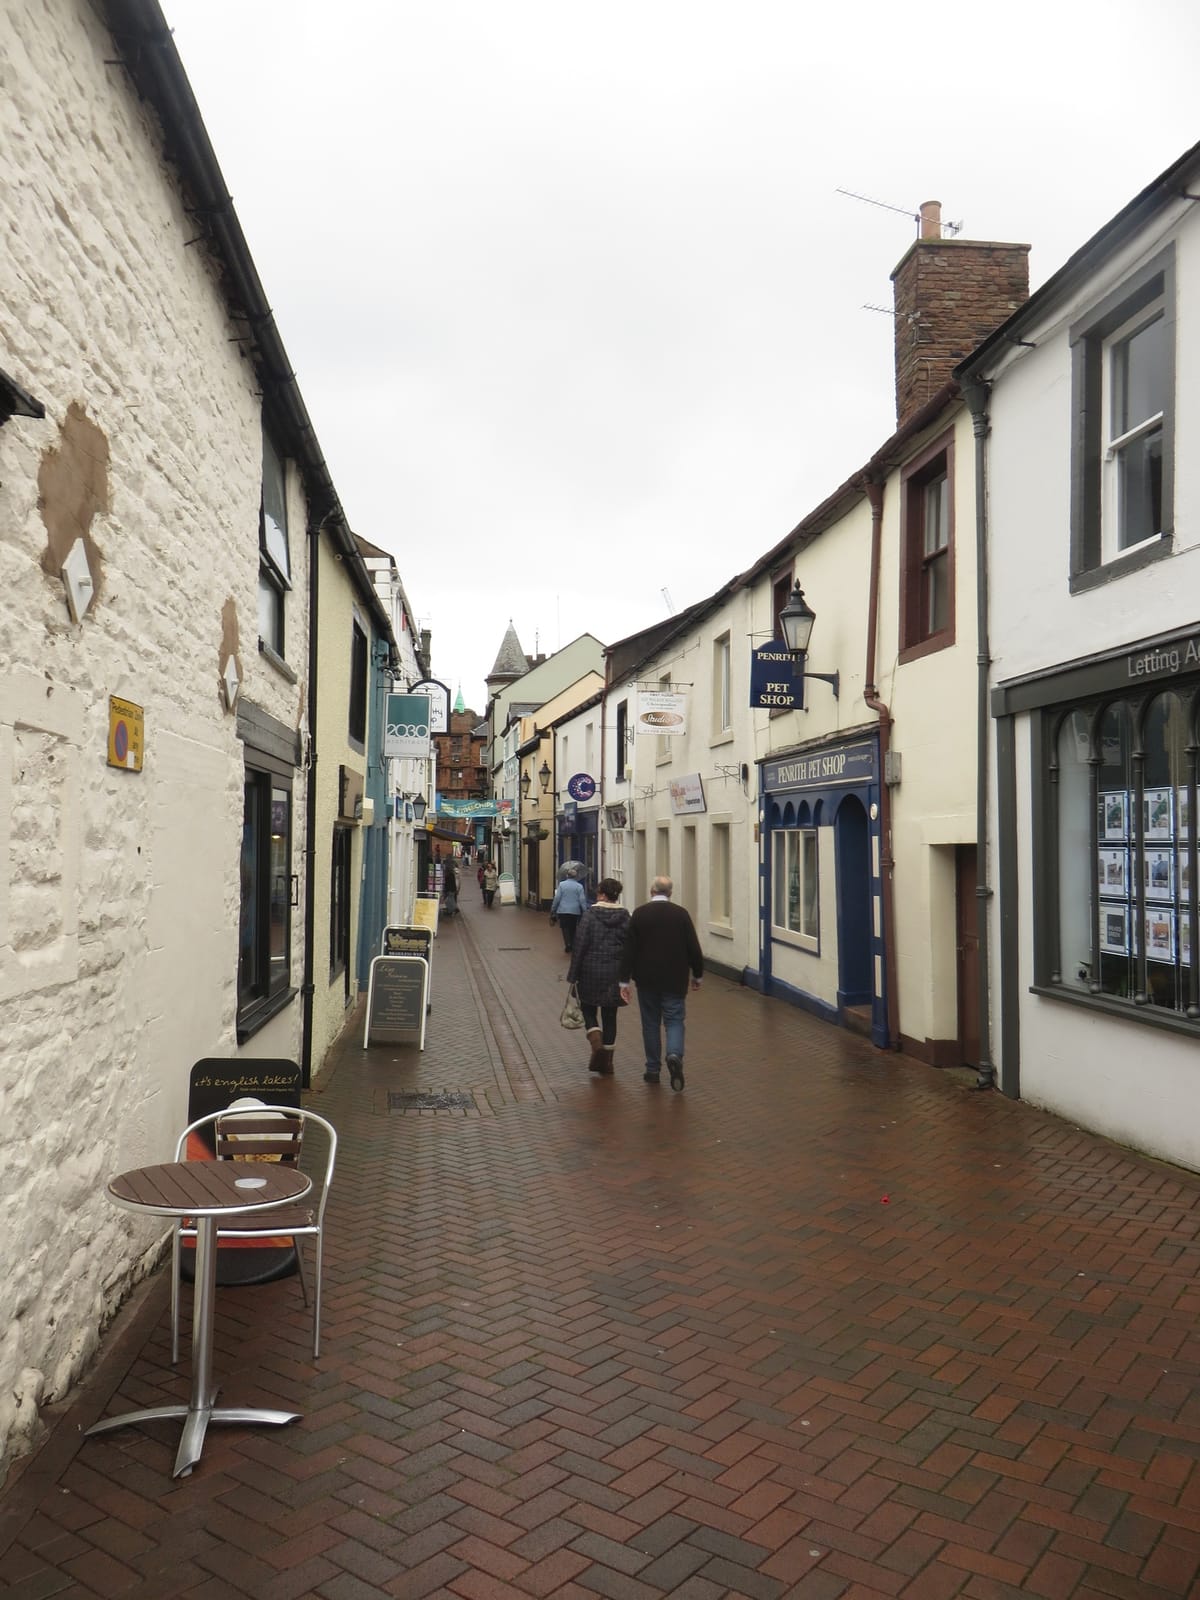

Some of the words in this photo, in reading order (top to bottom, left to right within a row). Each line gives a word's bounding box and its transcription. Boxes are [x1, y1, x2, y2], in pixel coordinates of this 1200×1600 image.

[1127, 648, 1179, 678] Letting
[1185, 639, 1200, 665] A
[766, 682, 790, 693] PET
[760, 694, 794, 705] SHOP
[387, 723, 428, 738] 2030
[777, 765, 806, 784] PENRITH
[808, 760, 821, 779] PET
[822, 753, 846, 775] SHOP
[195, 1075, 212, 1087] it's
[214, 1075, 259, 1093] english
